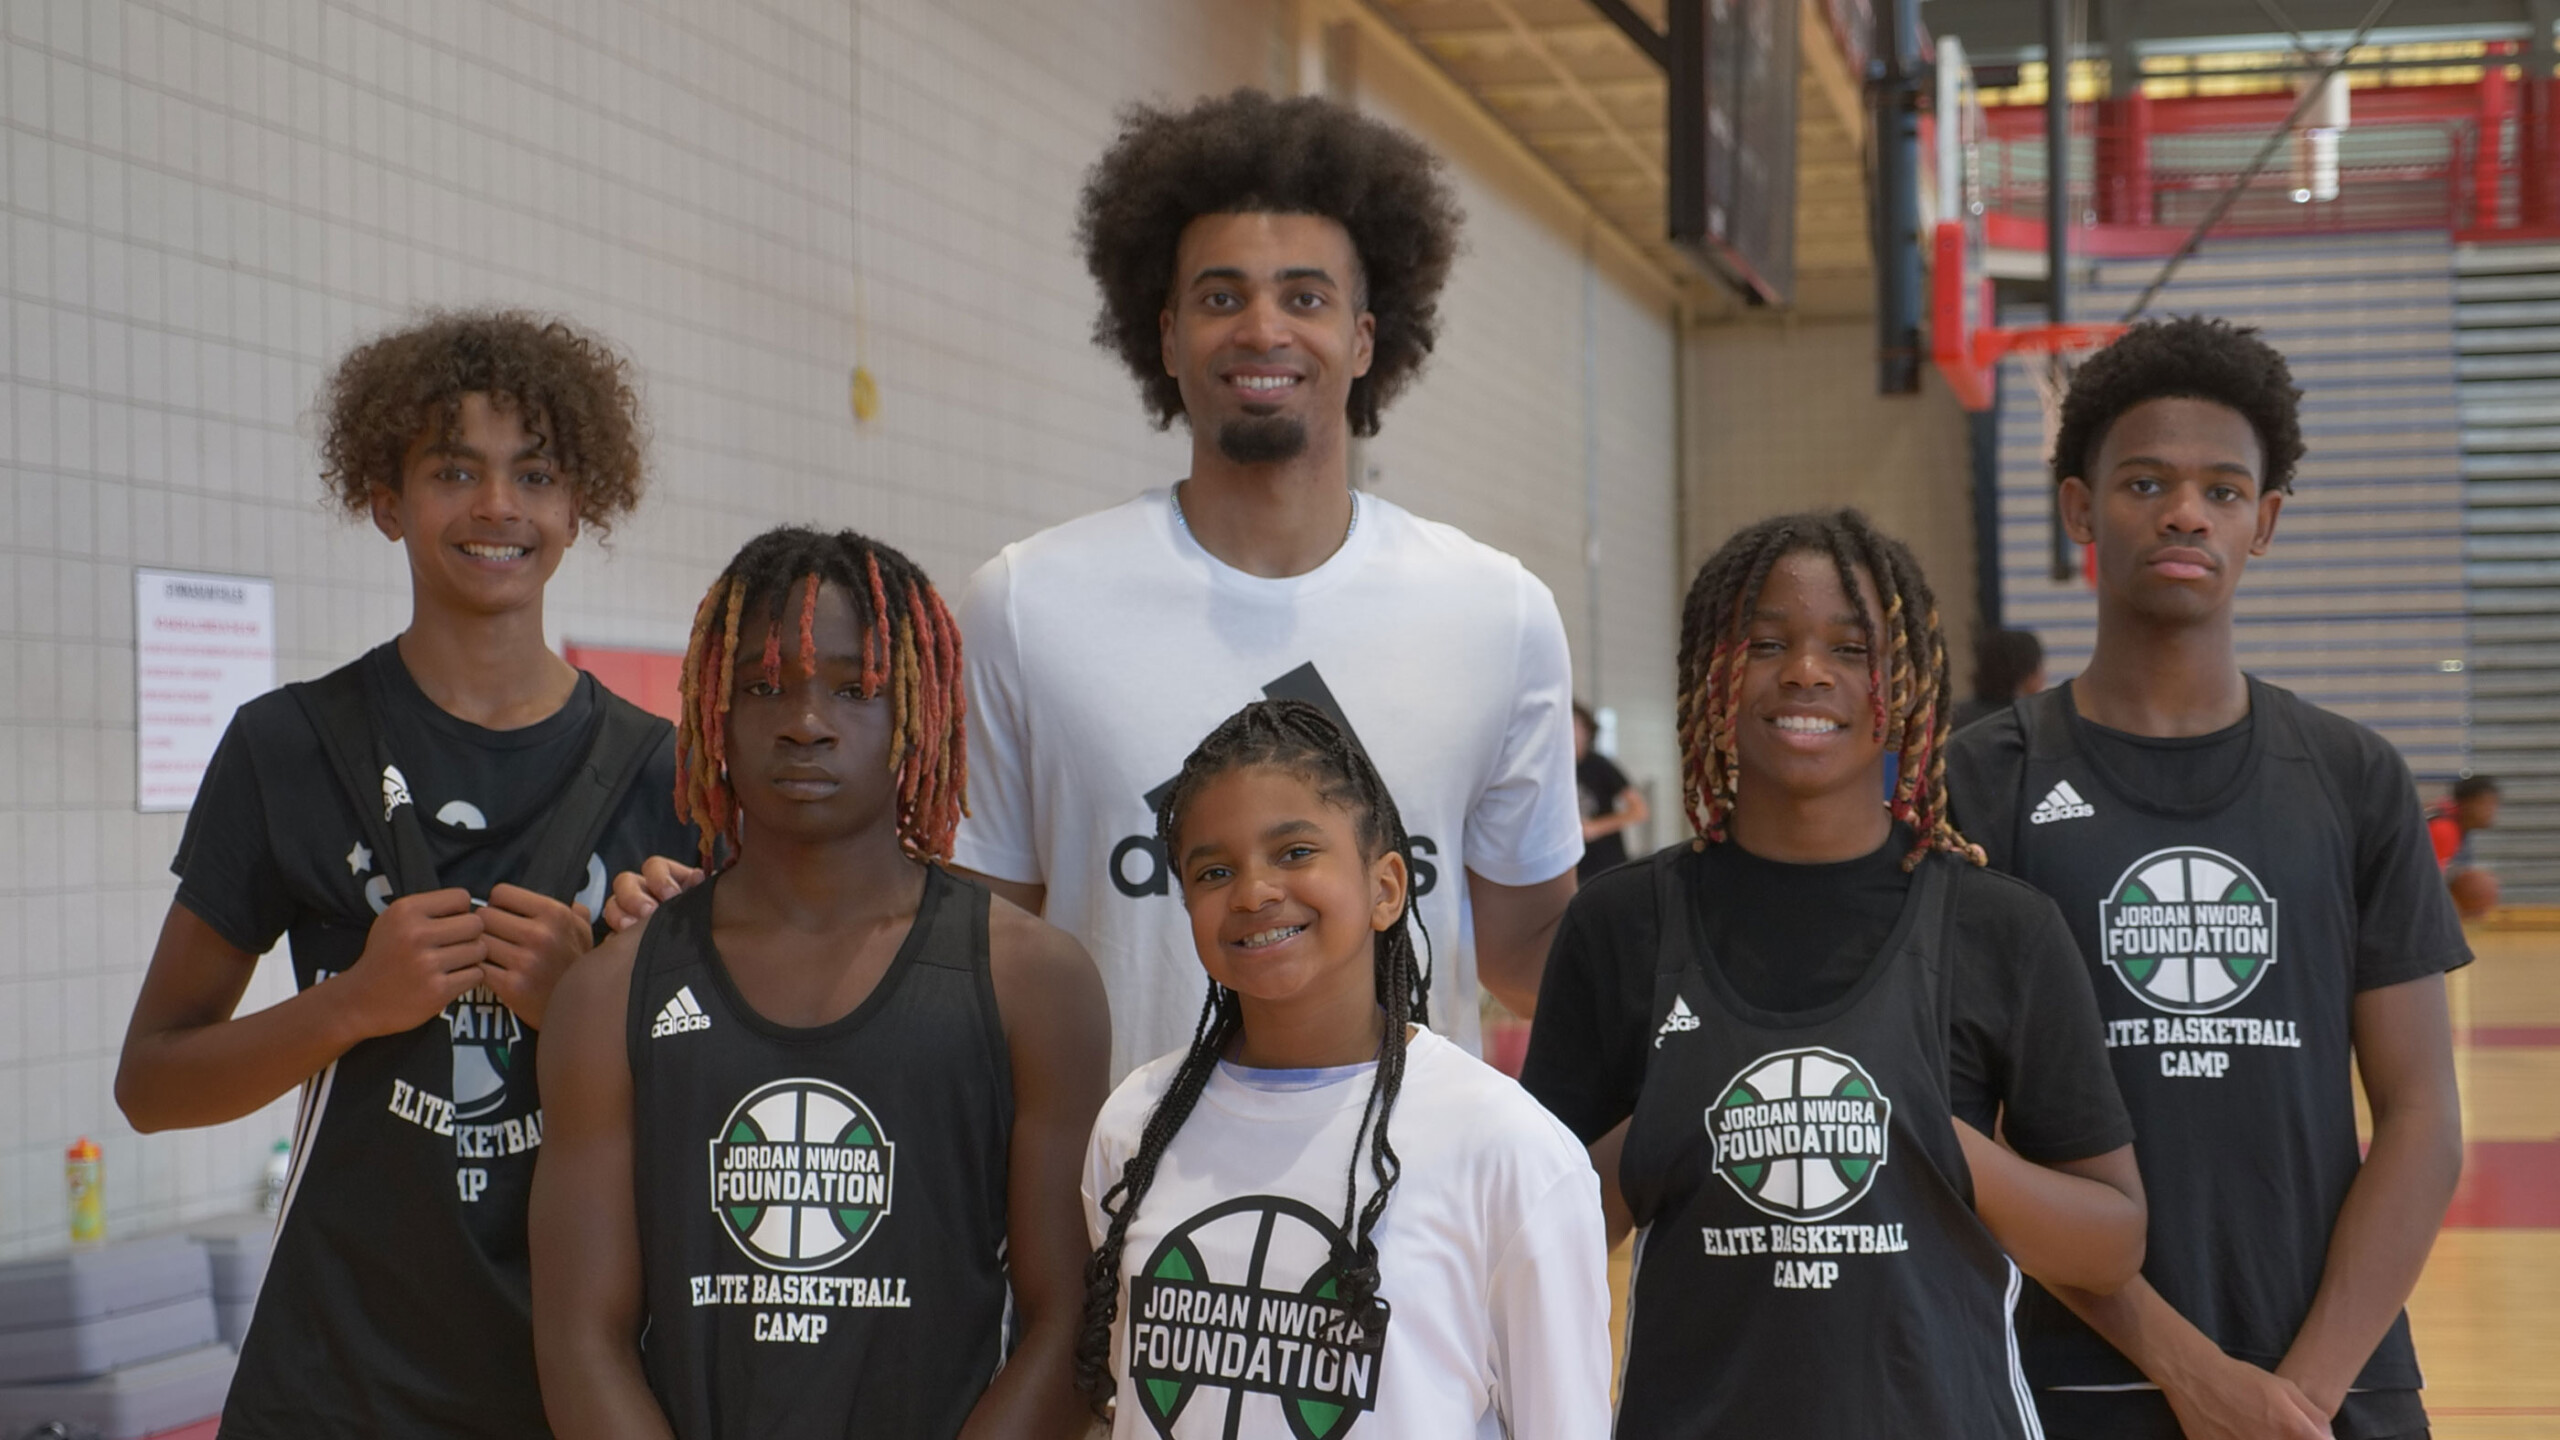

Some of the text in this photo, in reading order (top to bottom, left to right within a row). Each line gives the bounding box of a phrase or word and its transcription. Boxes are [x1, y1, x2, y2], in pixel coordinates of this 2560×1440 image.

[2031, 803, 2095, 824] adidas
[2114, 906, 2263, 927] JORDAN NWORA
[2109, 927, 2269, 955] FOUNDATION
[652, 1012, 711, 1038] adidas
[2103, 1019, 2301, 1048] ITE BASKETBALL
[2160, 1052, 2229, 1078] CAMP
[388, 1078, 456, 1137] ELITE
[1719, 1100, 1876, 1132] JORDAN NWORA
[1718, 1125, 1881, 1162] FOUNDATION
[723, 1146, 880, 1173] JORDAN NWORA
[717, 1171, 885, 1204] FOUNDATION
[1702, 1224, 1909, 1256] ELITE BASKETBALL
[1773, 1260, 1839, 1289] CAMP
[691, 1274, 911, 1308] ELITE BASKETBALL
[754, 1313, 828, 1344] CAMP
[1144, 1286, 1365, 1347] JORDAN NWORA
[1133, 1323, 1372, 1399] FOUNDATION
